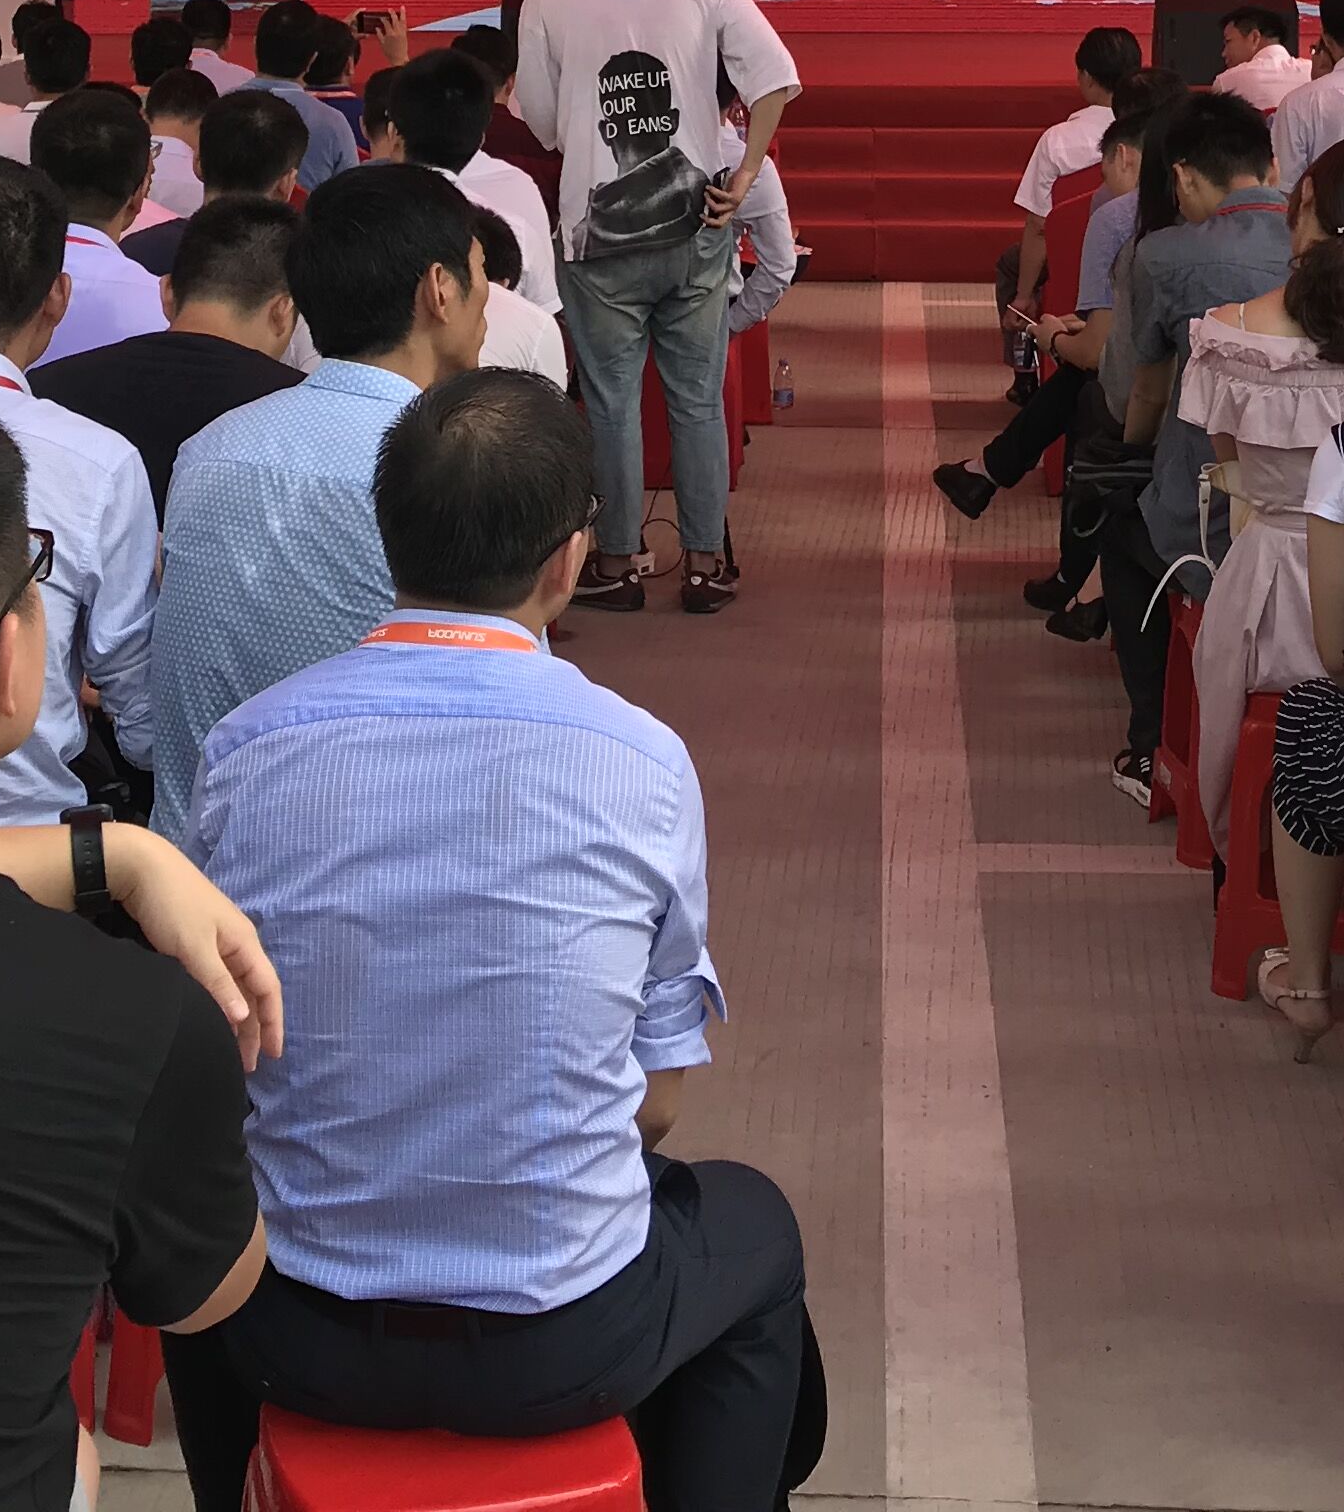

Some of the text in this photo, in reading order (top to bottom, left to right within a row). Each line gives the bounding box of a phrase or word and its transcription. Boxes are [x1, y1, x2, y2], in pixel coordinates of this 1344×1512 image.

[597, 70, 672, 94] WAKE UP
[602, 96, 637, 117] OUR
